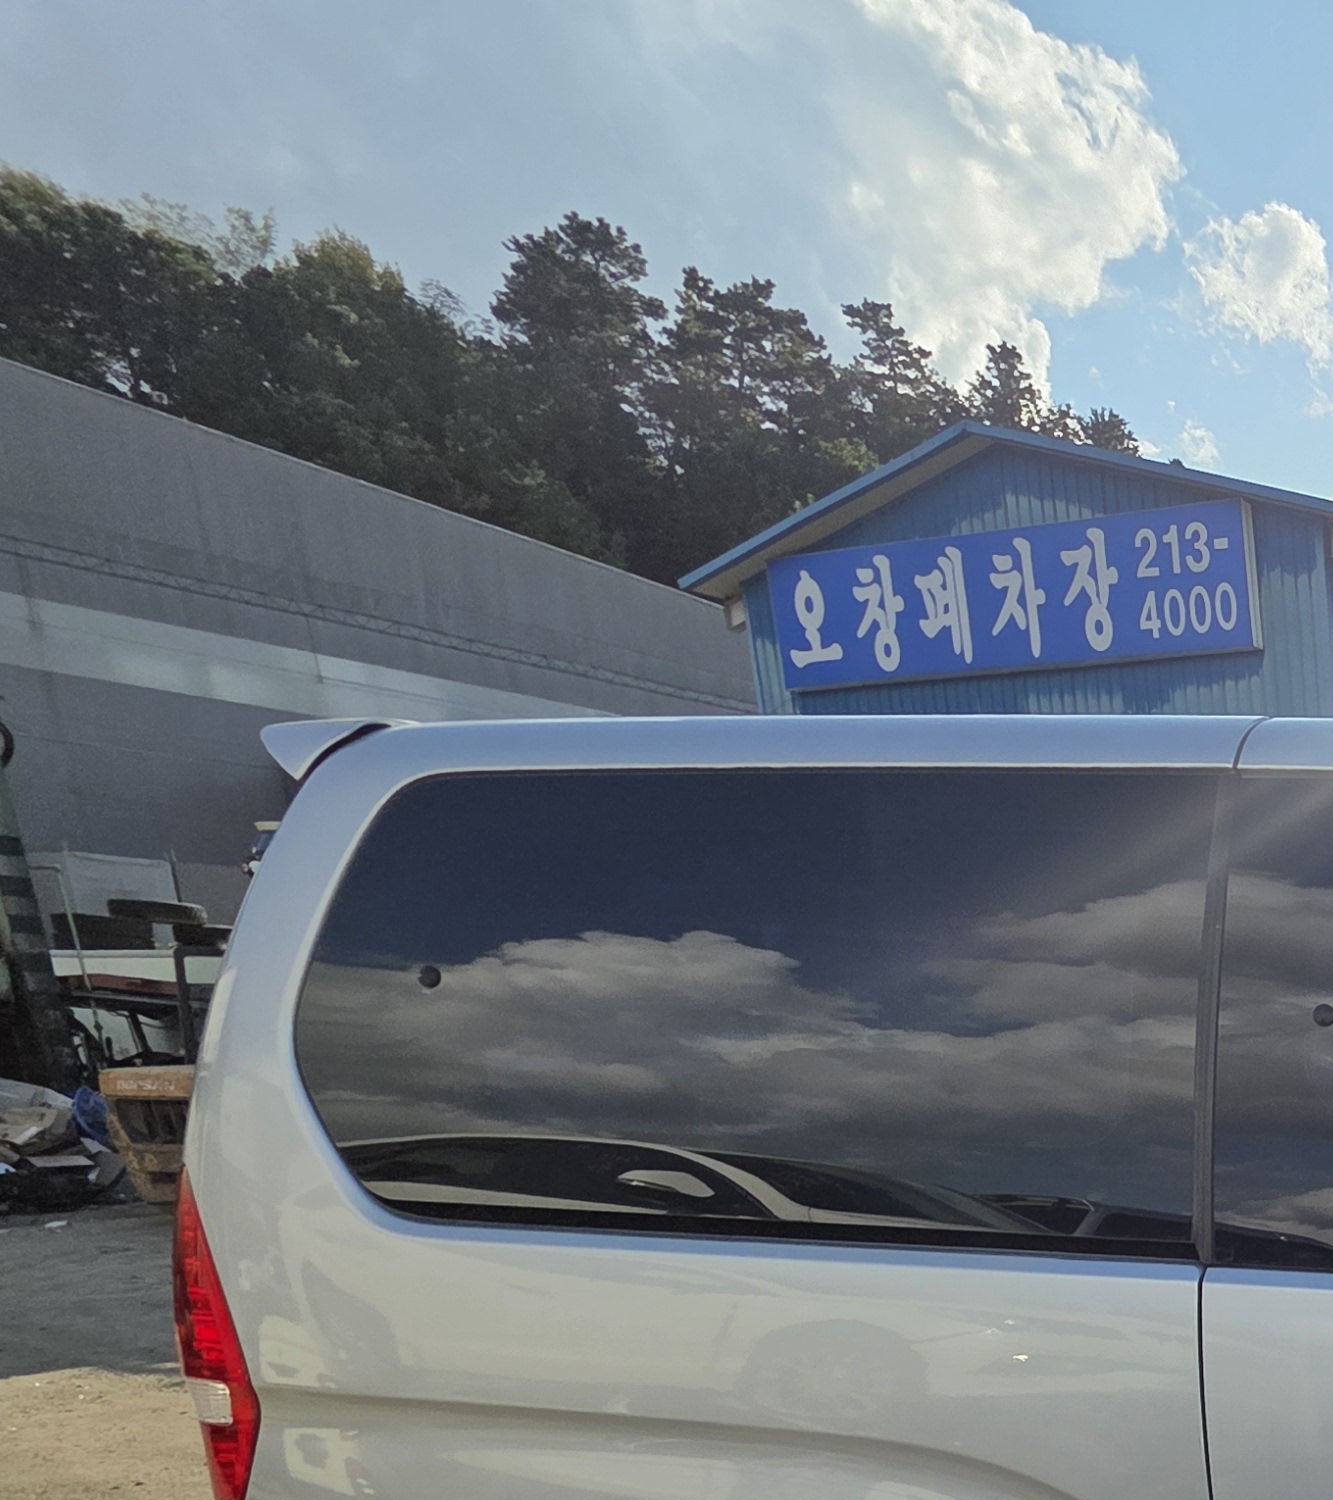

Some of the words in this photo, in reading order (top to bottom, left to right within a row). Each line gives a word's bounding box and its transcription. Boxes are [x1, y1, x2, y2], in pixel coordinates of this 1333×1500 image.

[1135, 522, 1229, 578] 213-
[790, 528, 1118, 672] 오창폐차장
[1138, 582, 1238, 638] 4000
